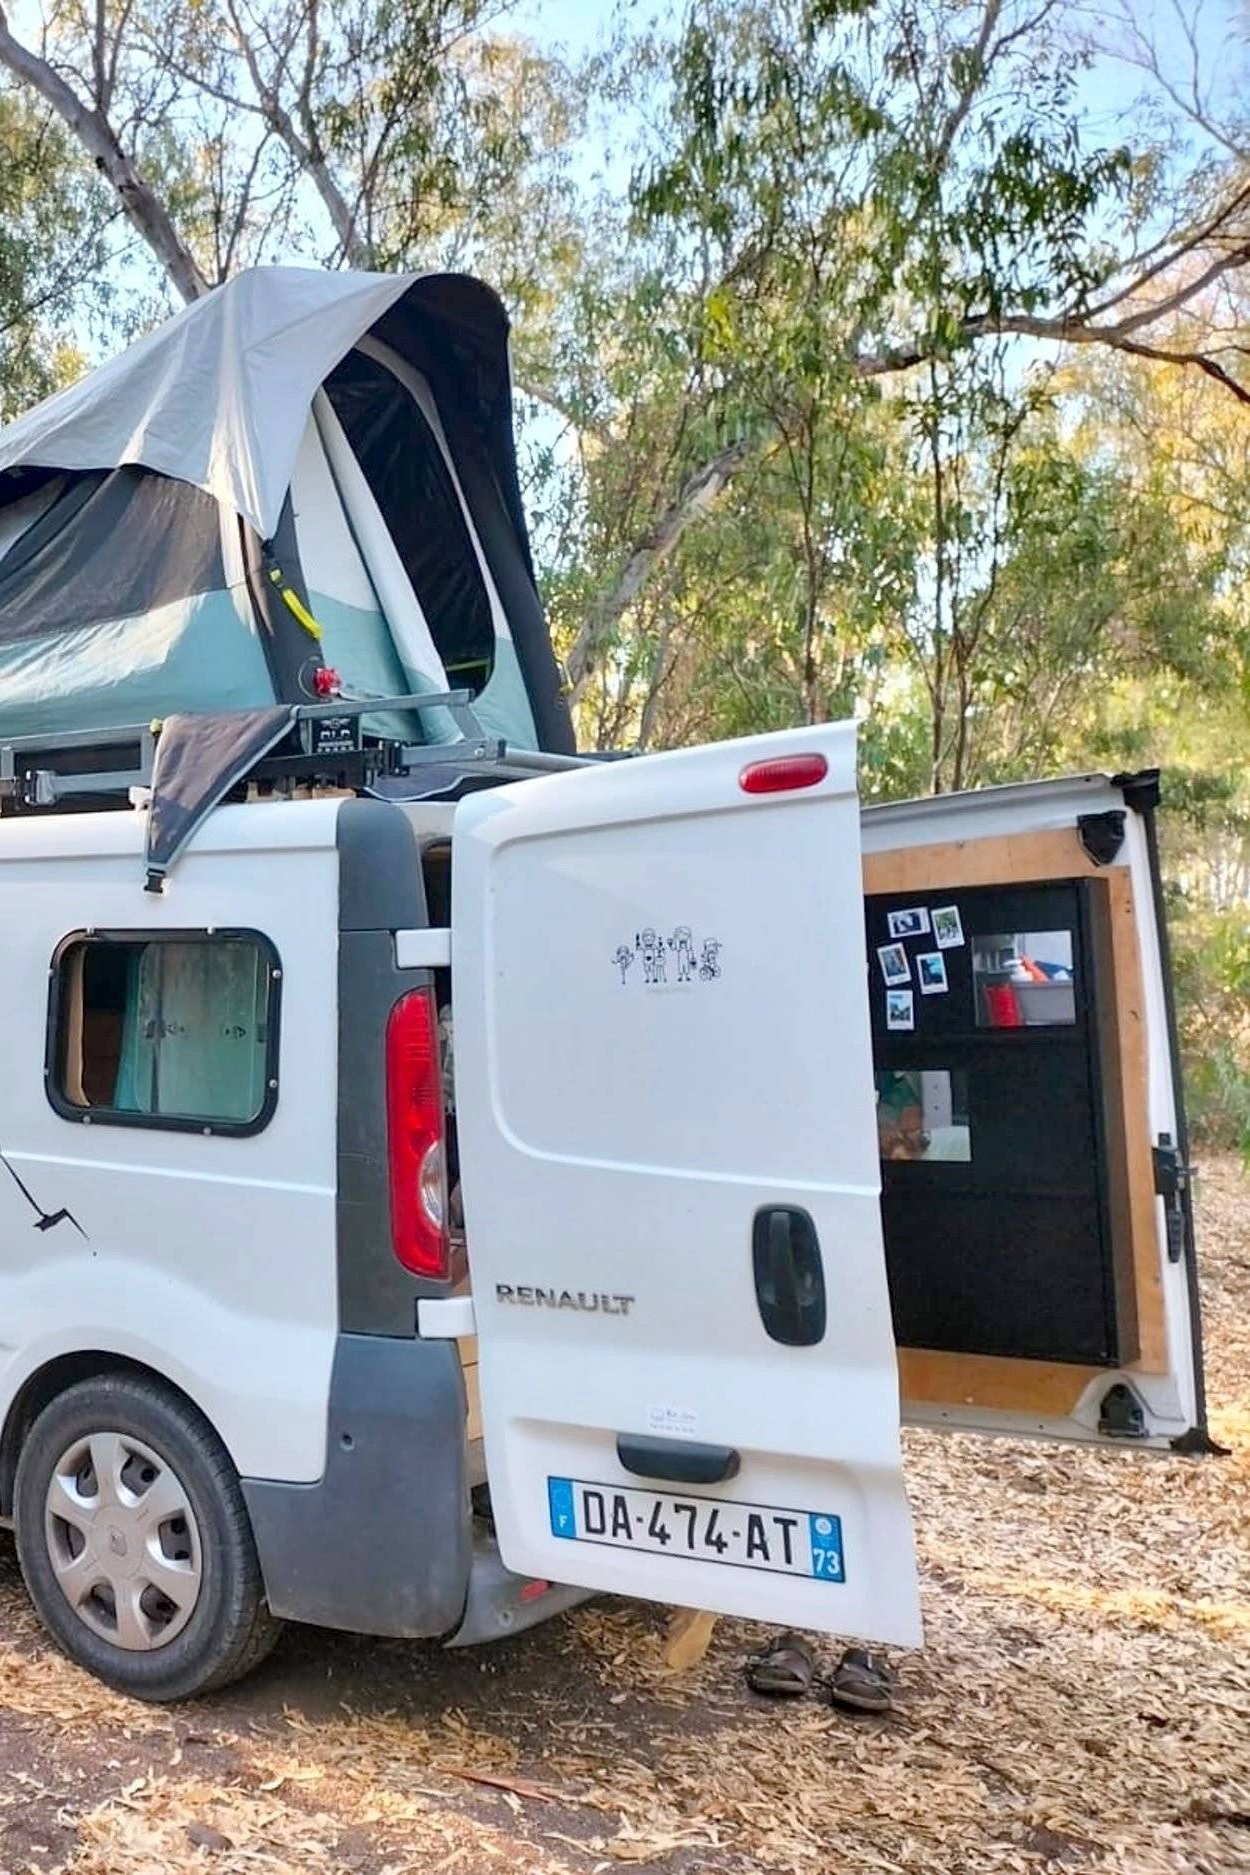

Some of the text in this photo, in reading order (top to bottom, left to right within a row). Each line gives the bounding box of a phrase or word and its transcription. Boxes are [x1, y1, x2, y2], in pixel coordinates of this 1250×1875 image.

[495, 1283, 636, 1316] RENAULT
[558, 1514, 569, 1529] F
[582, 1489, 798, 1565] DA-474-AT
[812, 1548, 840, 1575] 73
